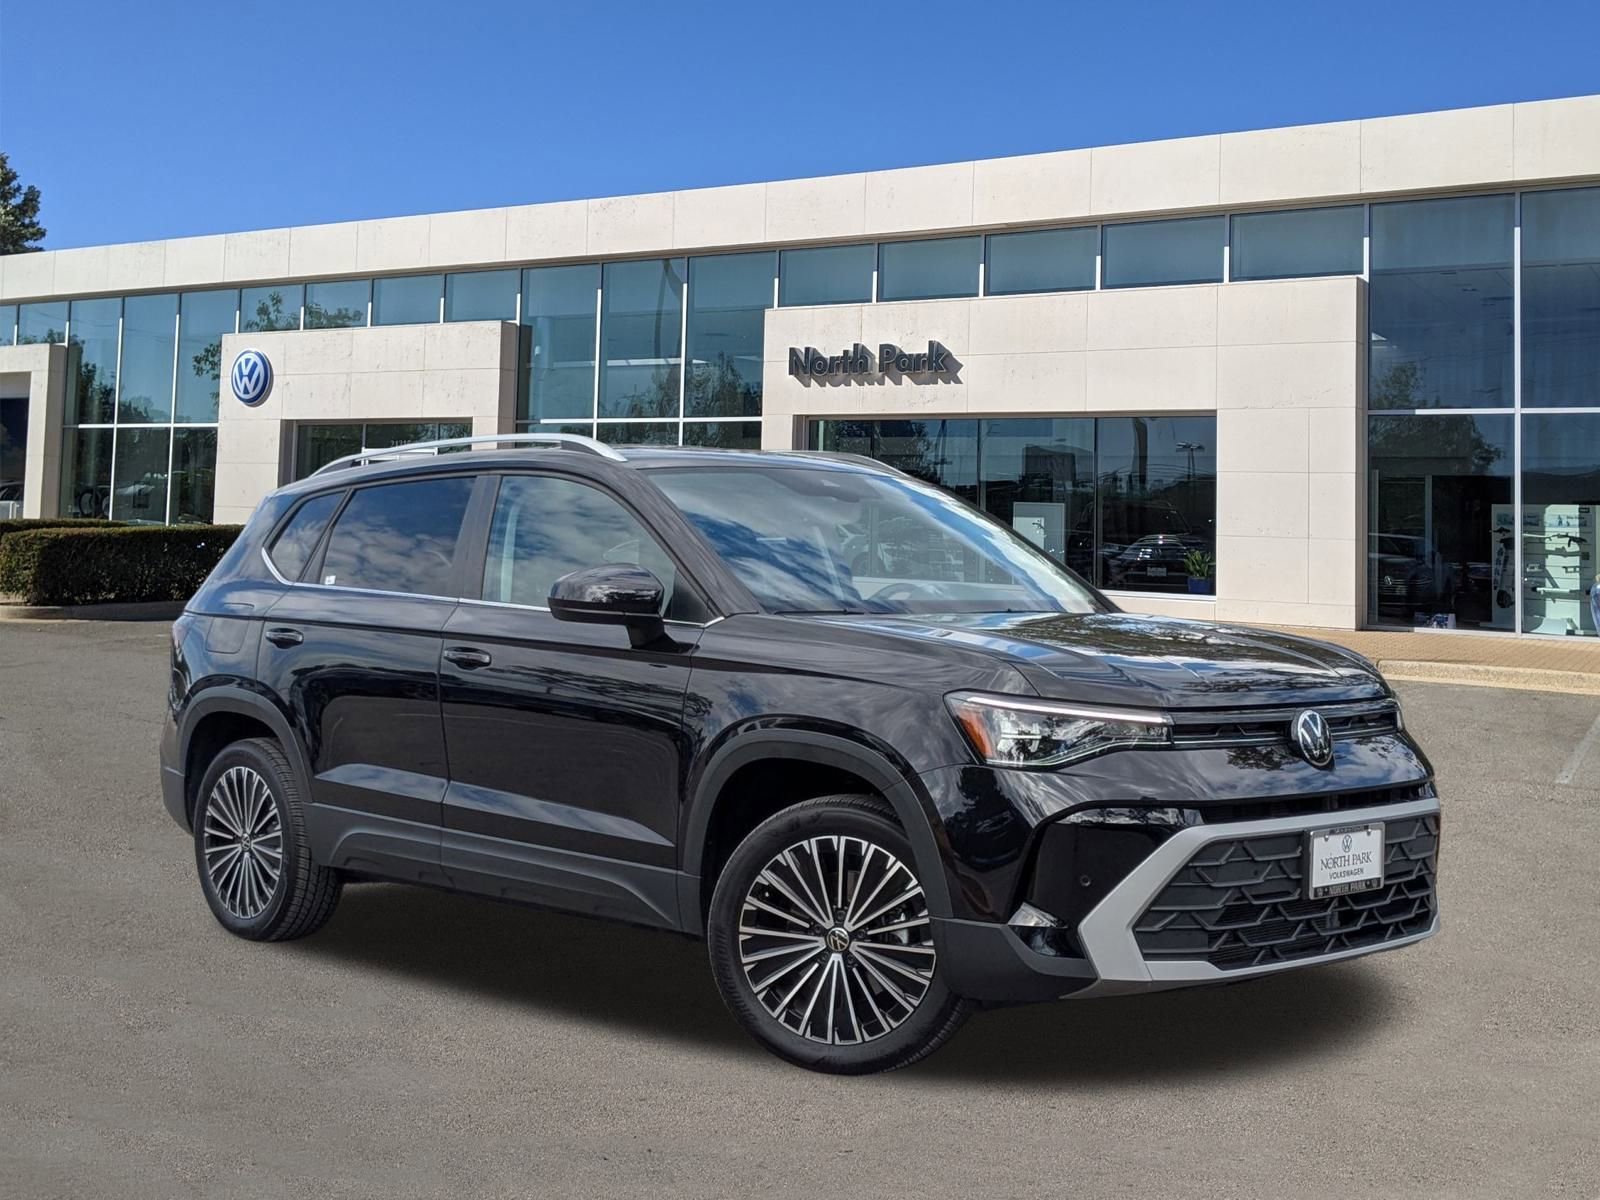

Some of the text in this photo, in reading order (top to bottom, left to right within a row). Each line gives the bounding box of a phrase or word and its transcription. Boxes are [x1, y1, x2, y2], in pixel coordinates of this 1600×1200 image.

[788, 340, 949, 377] North Park
[233, 352, 266, 400] VW
[1320, 851, 1373, 871] NORTH PARK
[1328, 867, 1365, 880] VOLKSWAGEN
